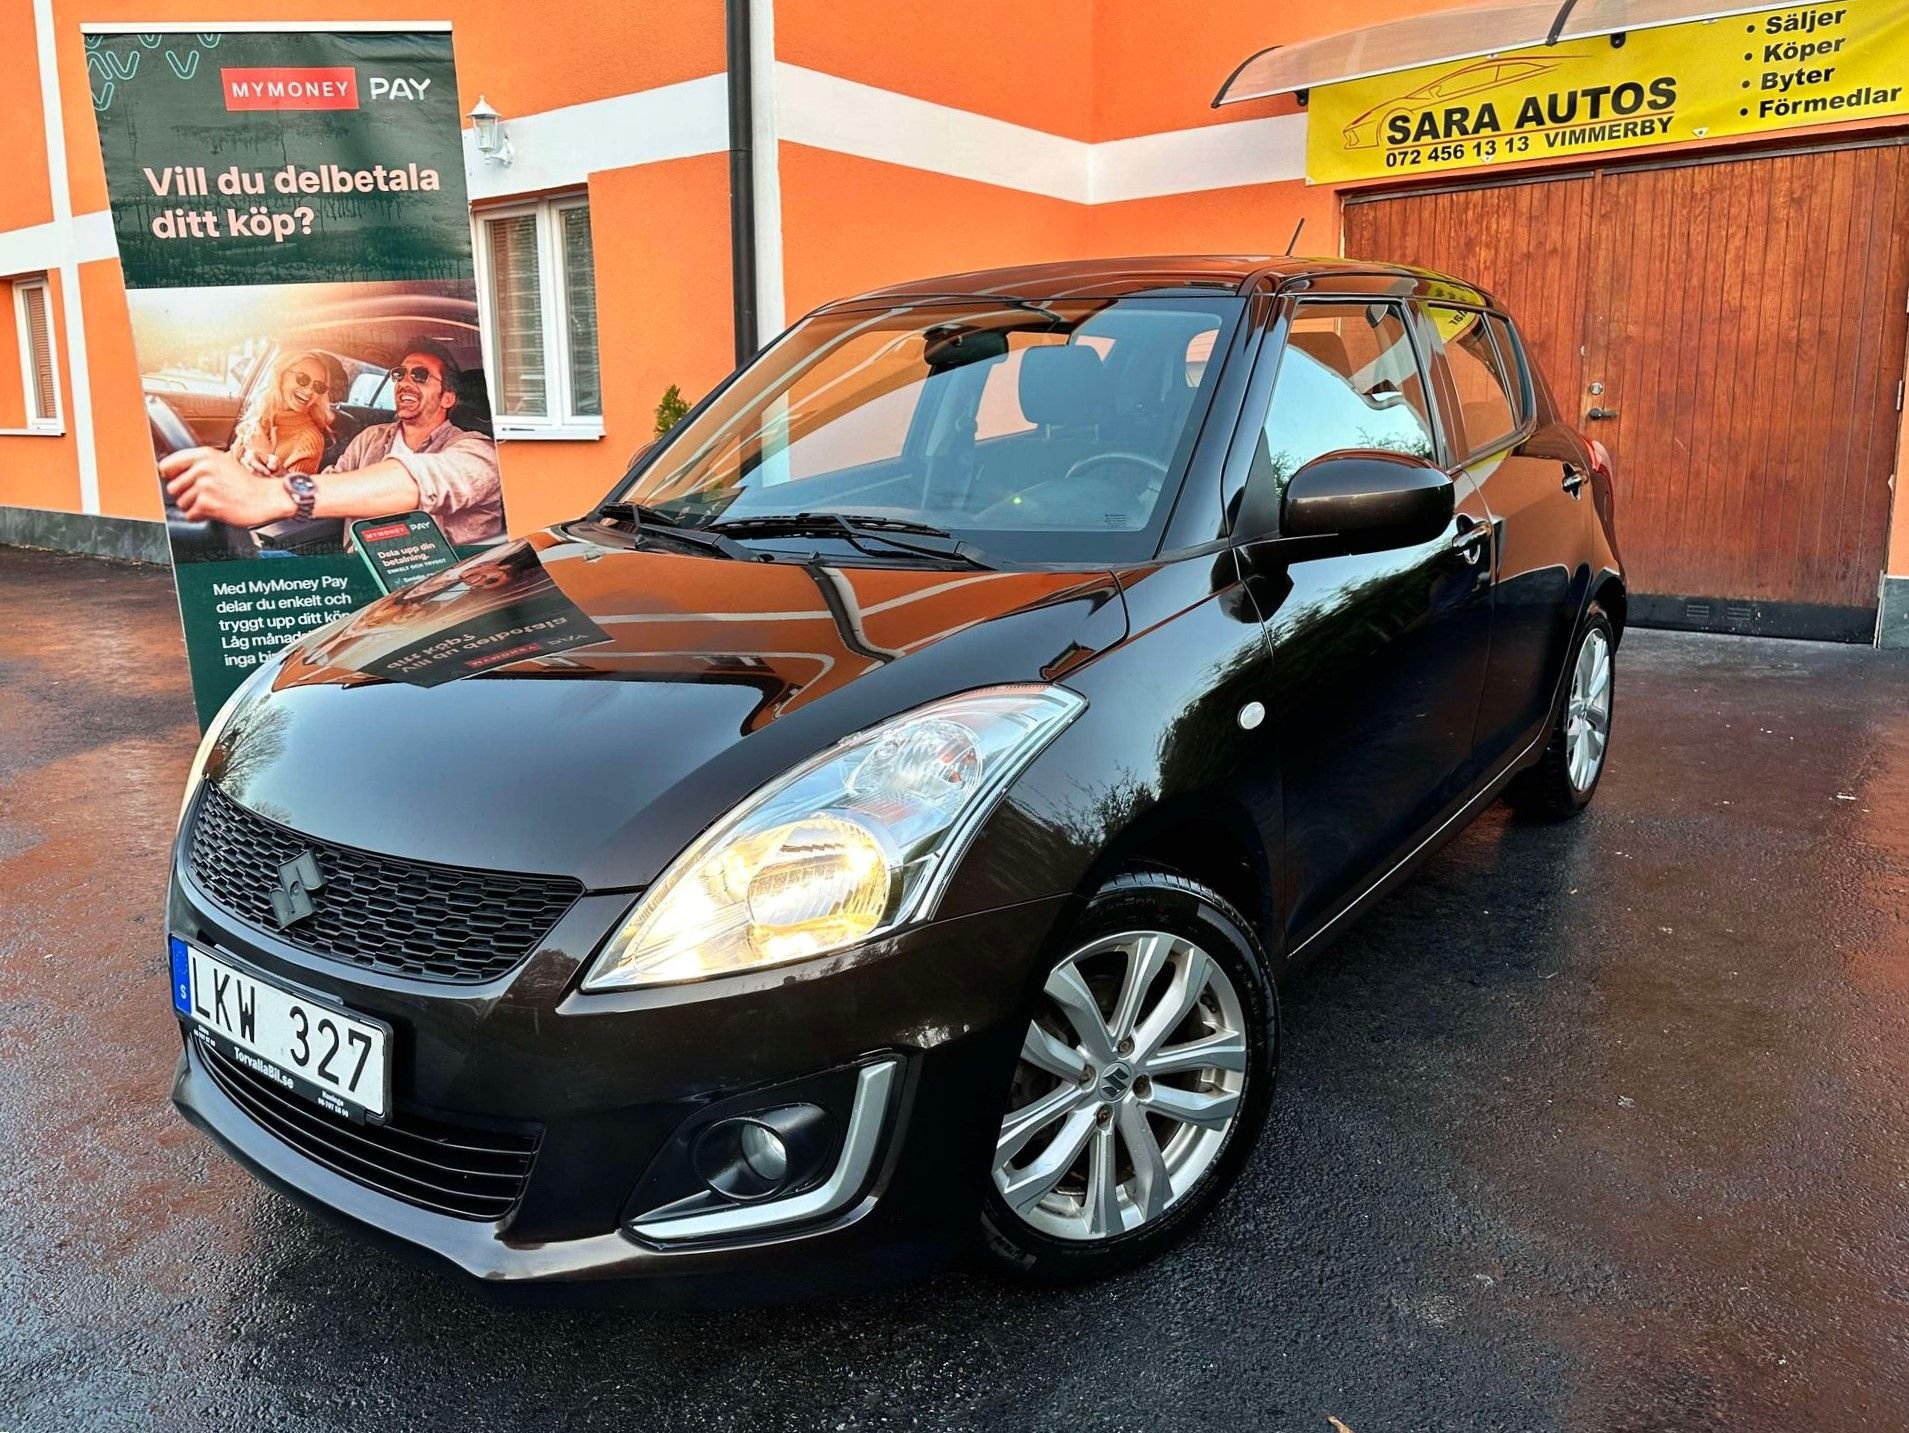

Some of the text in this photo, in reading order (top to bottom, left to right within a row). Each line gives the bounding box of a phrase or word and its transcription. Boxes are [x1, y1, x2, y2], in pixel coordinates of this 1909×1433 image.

[1765, 9, 1847, 35] Säljer
[1763, 38, 1847, 63] Köper
[231, 77, 431, 100] MYMONEY PAY
[1760, 67, 1836, 93] Byter
[1386, 76, 1678, 146] SARA AUTOS
[1759, 87, 1904, 118] Förmedlar
[1385, 116, 1674, 168] 072 456 13 13 VIMMERBY
[143, 162, 441, 197] Vill du delbetala
[151, 206, 315, 243] ditt köp?
[409, 521, 431, 531] PAY
[377, 542, 436, 559] Dela upp din
[382, 552, 430, 567] betalning.
[212, 575, 349, 596] Med MyMoney Pay
[216, 592, 352, 613] delar du enkelt och
[218, 616, 264, 633] tryggt
[267, 616, 296, 630] upp
[298, 611, 322, 625] ditt
[221, 635, 250, 650] Låg
[224, 653, 256, 668] inga
[179, 984, 187, 999] S
[192, 957, 373, 1093] LKW 327
[233, 1046, 295, 1090] TorvallaBil.se
